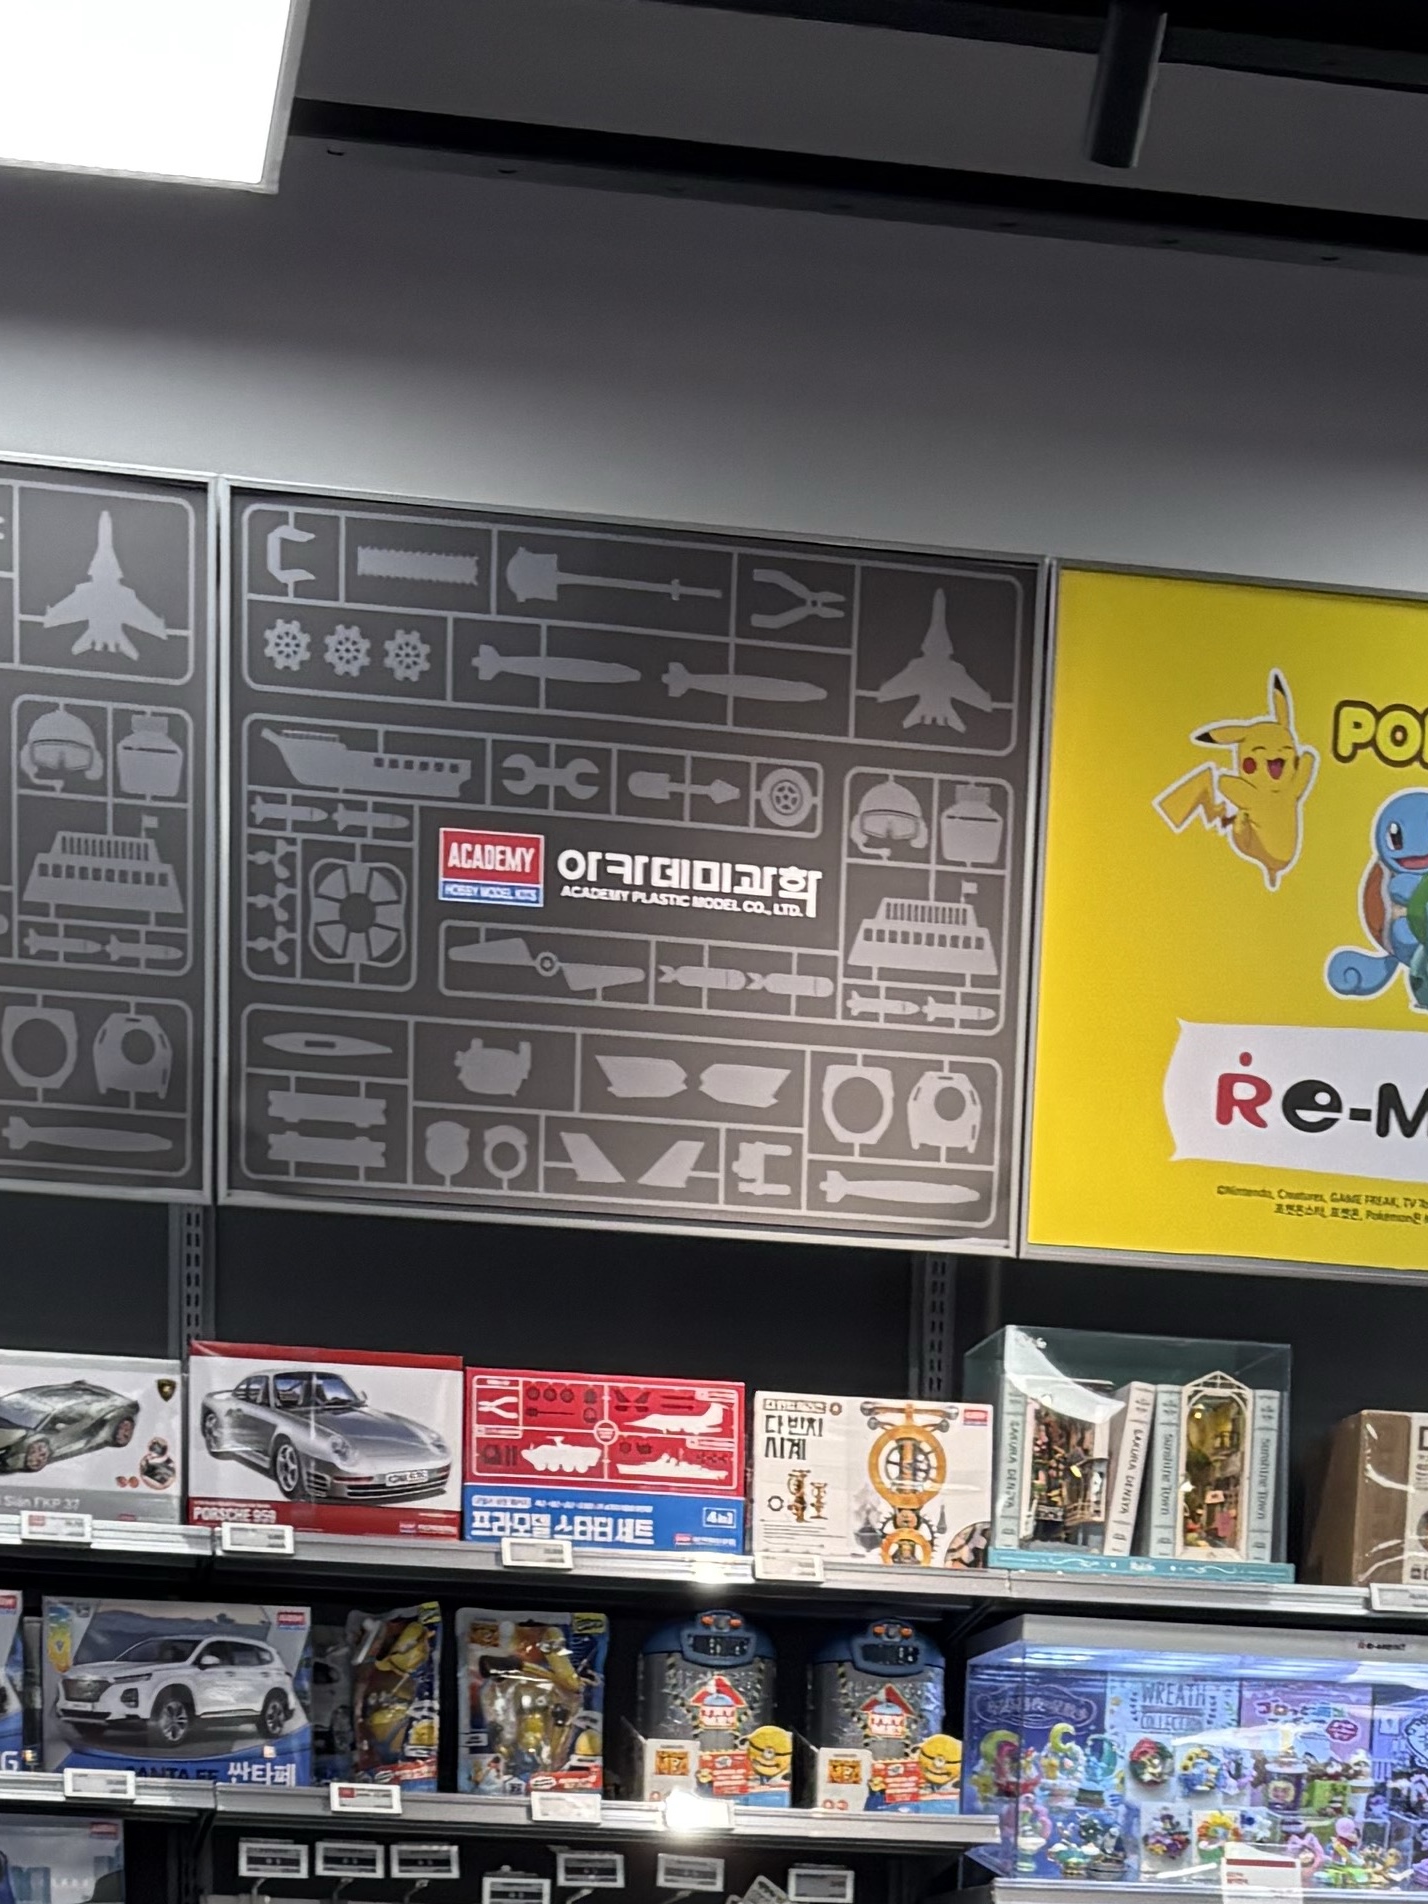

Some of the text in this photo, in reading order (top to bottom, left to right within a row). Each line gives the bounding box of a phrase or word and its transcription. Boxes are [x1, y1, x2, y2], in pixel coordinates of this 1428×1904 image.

[447, 842, 535, 873] ACADEMY
[557, 849, 822, 918] 아카데미과학
[559, 885, 630, 902] ACADEMY
[632, 890, 691, 908] PLASTIC
[692, 895, 741, 912] MODEL
[773, 902, 803, 918] LTD.
[763, 1436, 807, 1461] 시계
[192, 1506, 251, 1522] PORSCHE
[616, 1517, 655, 1546] 세트
[1140, 1682, 1207, 1708] WREATH
[227, 1760, 297, 1787] 싼타페
